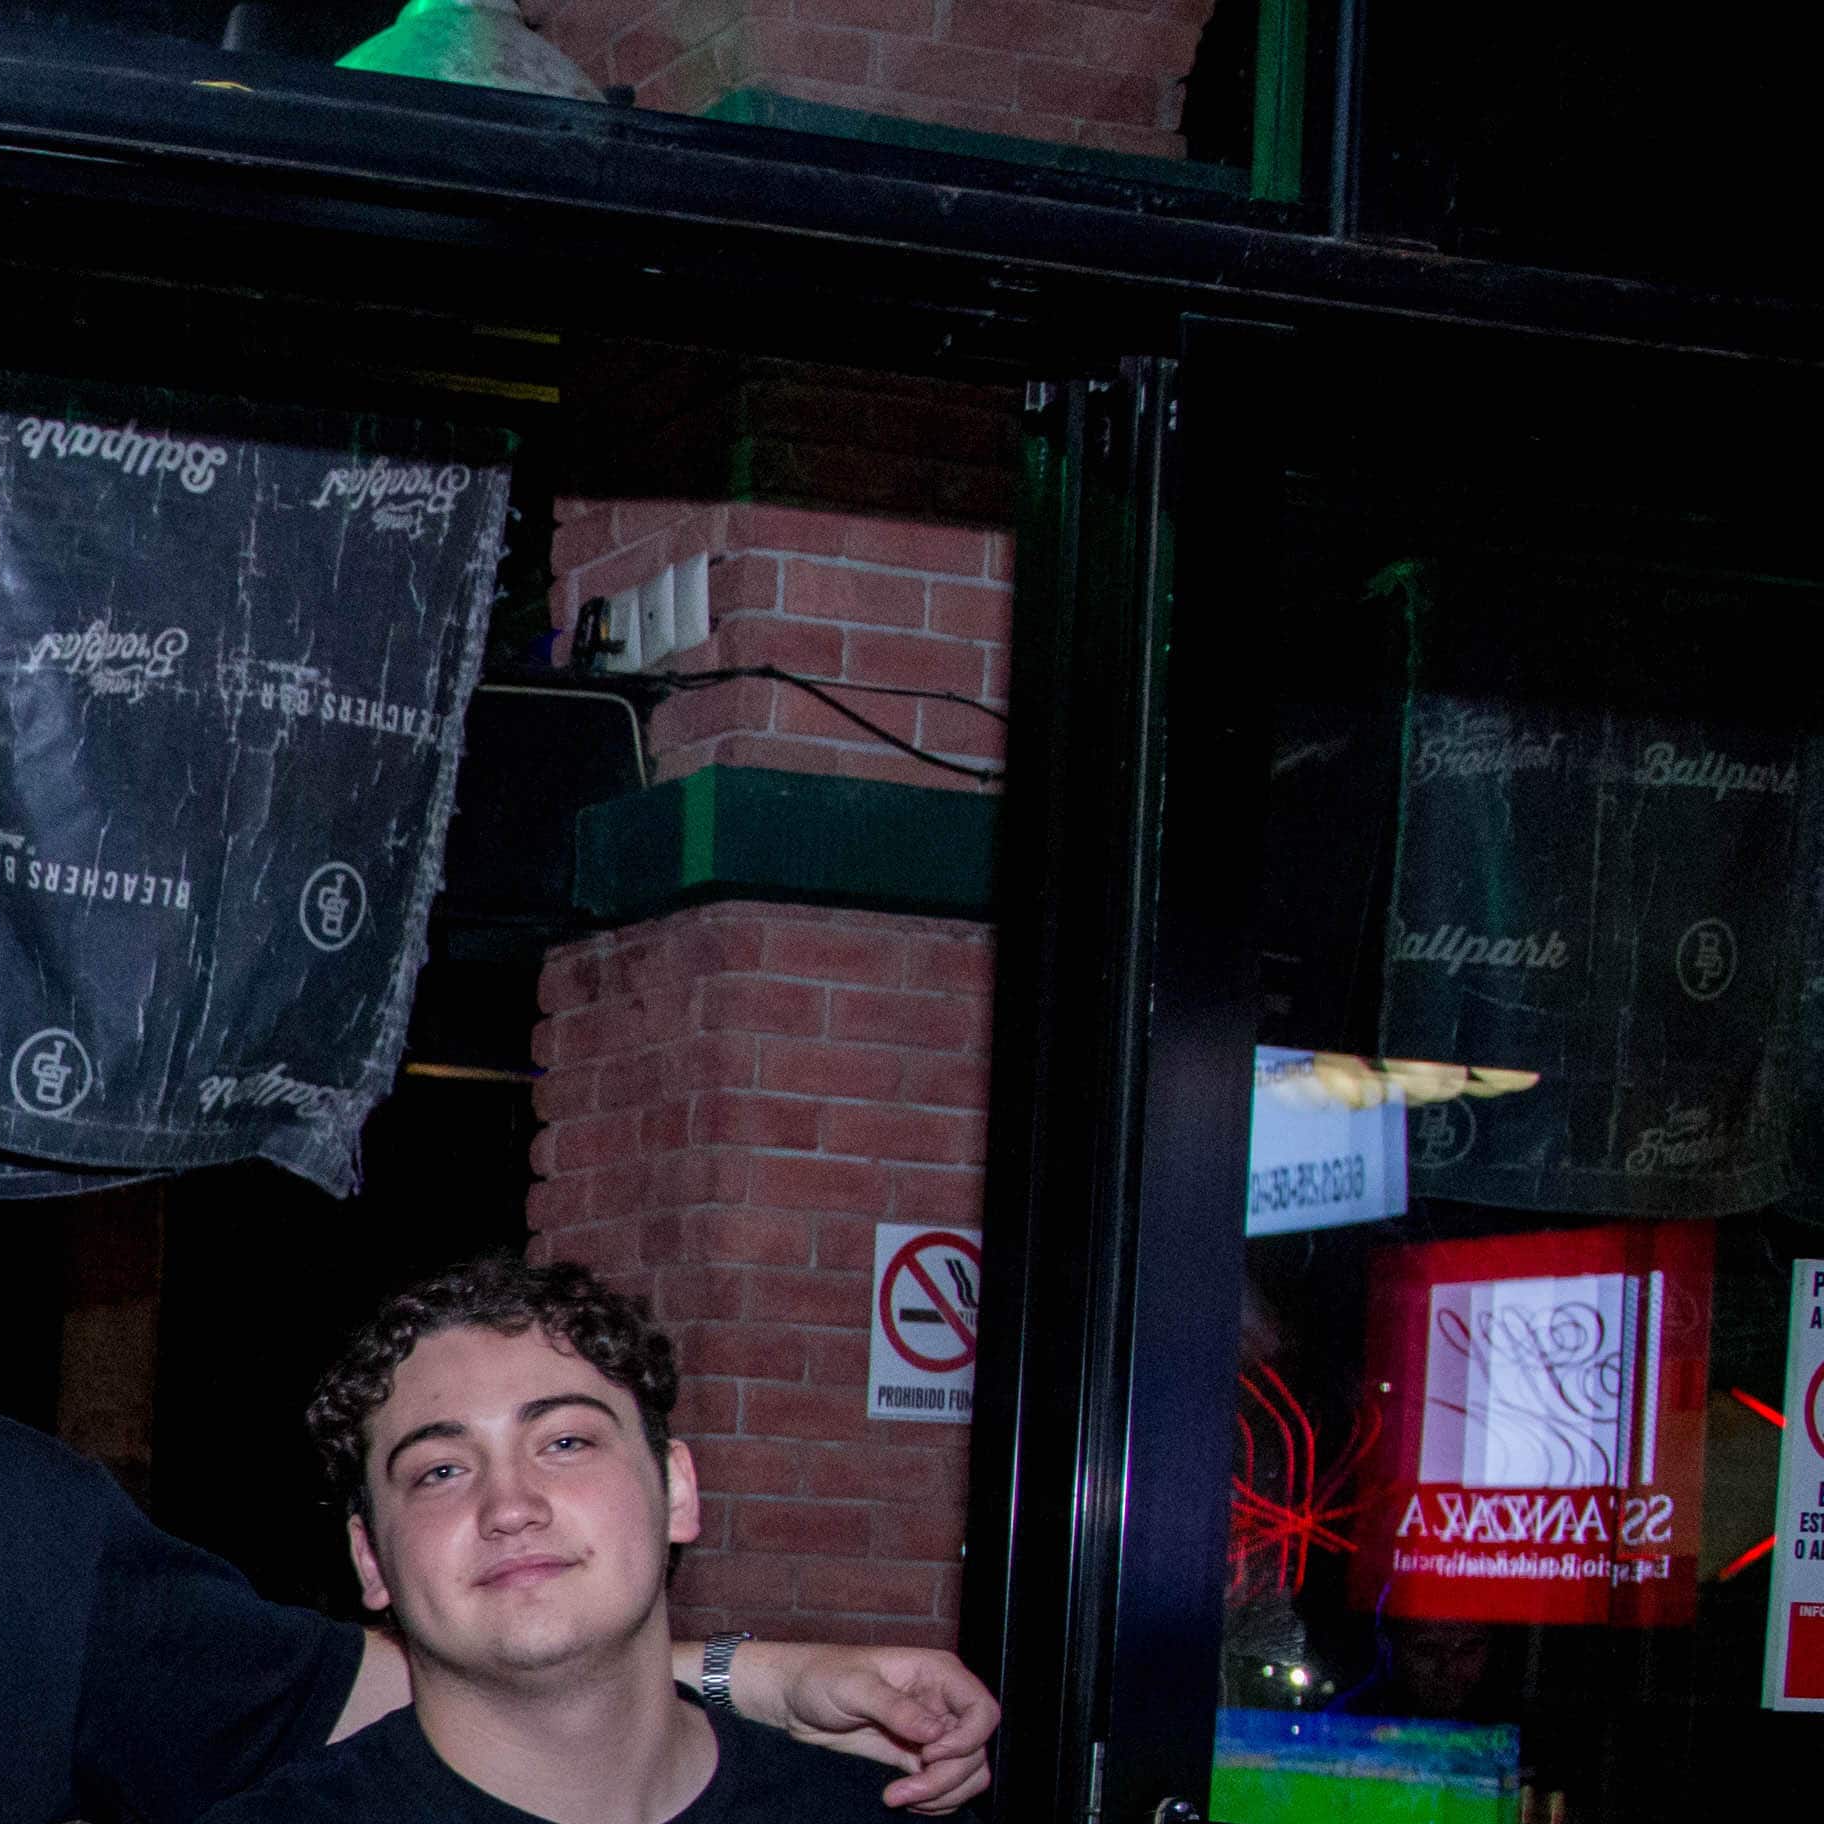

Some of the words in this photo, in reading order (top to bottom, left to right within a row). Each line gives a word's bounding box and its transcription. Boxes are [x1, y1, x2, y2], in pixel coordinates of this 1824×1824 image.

[17, 416, 228, 493] Ballpark
[310, 456, 470, 513] Breakfast
[21, 619, 190, 678] Breakfast
[28, 859, 192, 909] BLEACHERS
[878, 1386, 945, 1409] PROHIBIDO
